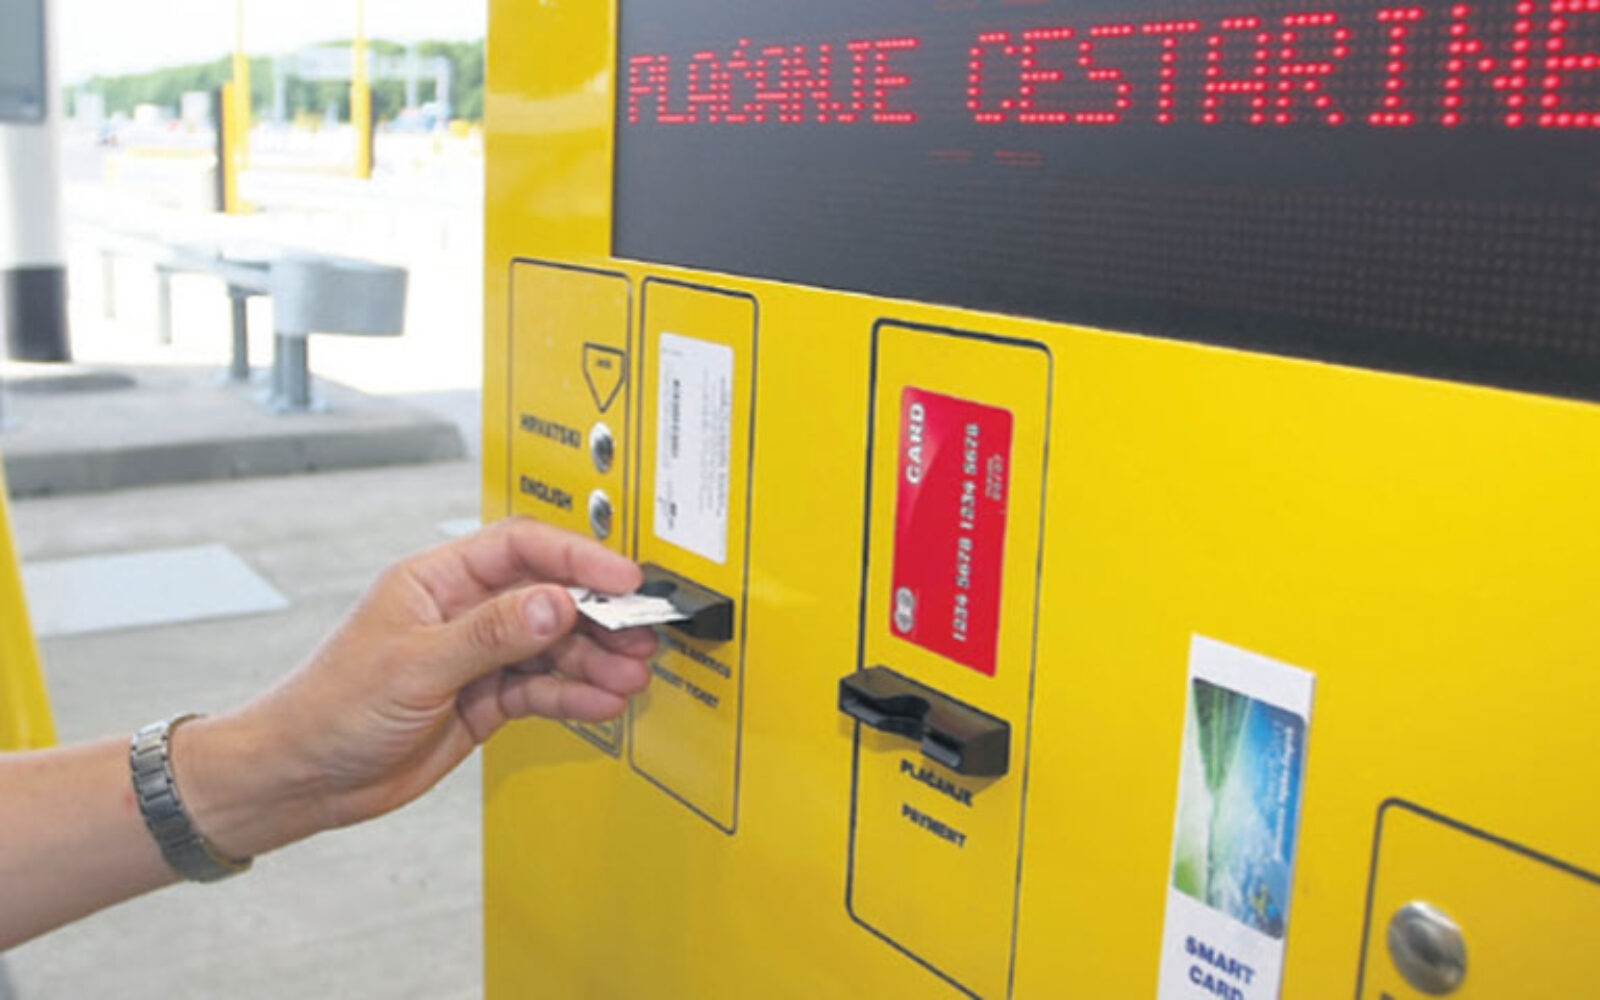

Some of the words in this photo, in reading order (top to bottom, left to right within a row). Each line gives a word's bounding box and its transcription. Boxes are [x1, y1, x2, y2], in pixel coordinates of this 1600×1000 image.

[628, 36, 920, 124] PLAĆANJE
[966, 0, 1600, 128] CESTARINE
[906, 402, 926, 486] CARD
[519, 475, 574, 512] ENGLISH
[901, 803, 967, 848] PAYMENT
[1185, 935, 1256, 985] SMART
[1188, 965, 1245, 1000] CARD
